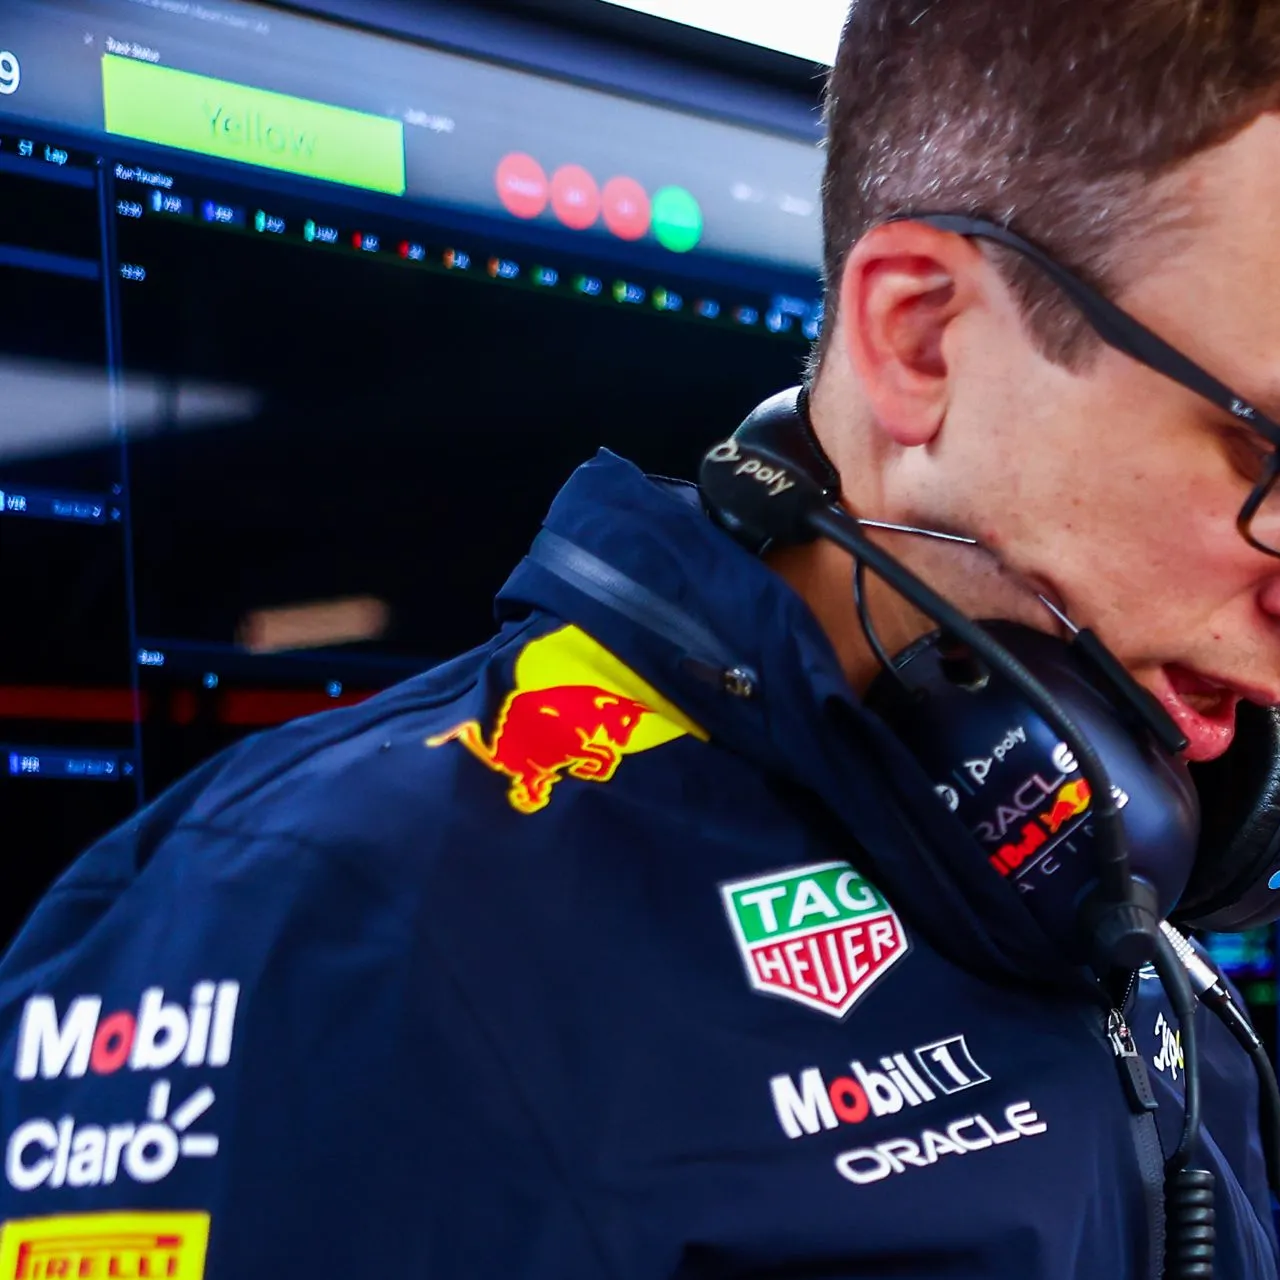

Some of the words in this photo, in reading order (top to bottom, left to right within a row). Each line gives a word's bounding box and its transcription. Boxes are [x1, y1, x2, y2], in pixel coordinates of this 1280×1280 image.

[203, 99, 319, 158] Yellow
[735, 459, 796, 497] poly
[994, 726, 1026, 762] poly
[972, 741, 1079, 842] RACLE
[741, 866, 878, 933] TAG
[755, 920, 896, 1004] HEUER
[14, 980, 240, 1080] Mobil
[770, 1053, 937, 1139] Mobil
[931, 1045, 972, 1087] 1
[835, 1101, 1048, 1185] ORACLE
